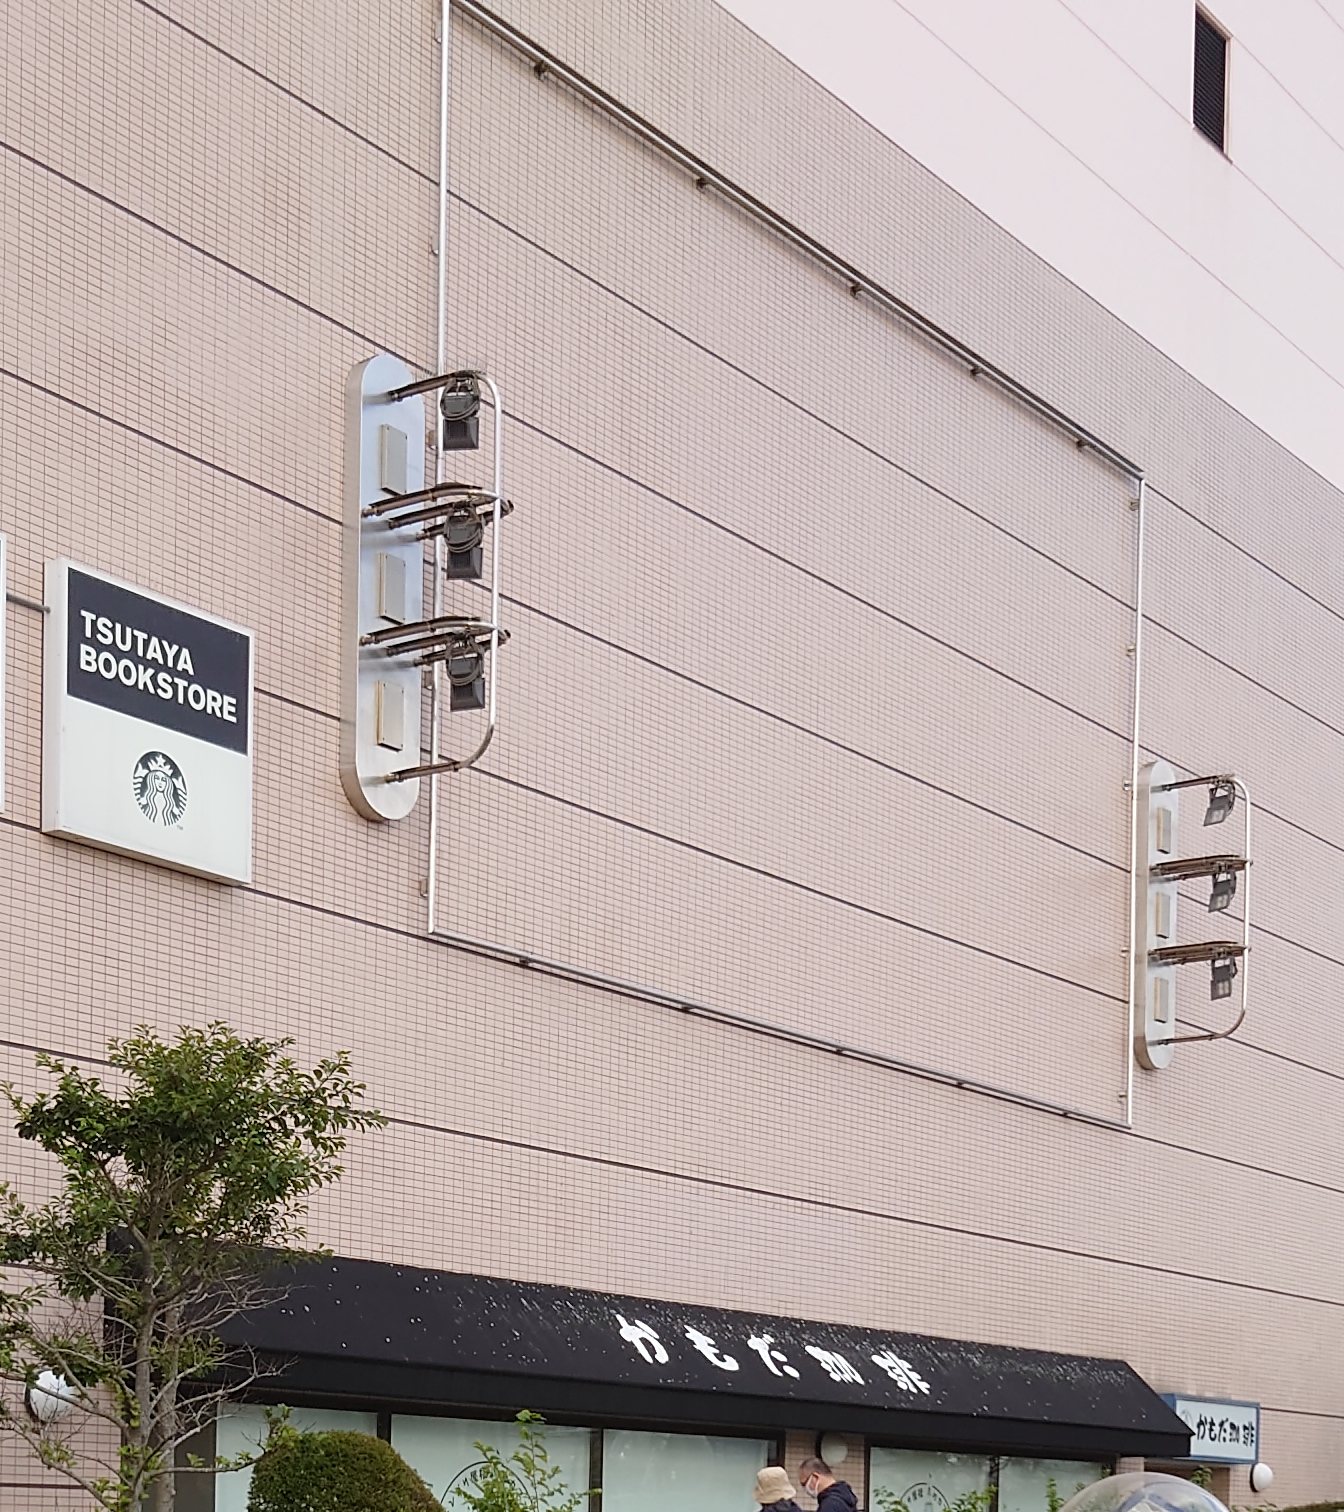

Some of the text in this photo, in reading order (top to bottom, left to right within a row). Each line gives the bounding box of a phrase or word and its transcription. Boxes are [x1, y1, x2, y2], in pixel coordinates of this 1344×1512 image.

[80, 609, 195, 676] TSUTAYA
[79, 643, 238, 724] BOOKSTORE
[613, 1313, 931, 1395] かもだ珈琲
[1196, 1413, 1255, 1447] かもだ珈琲
